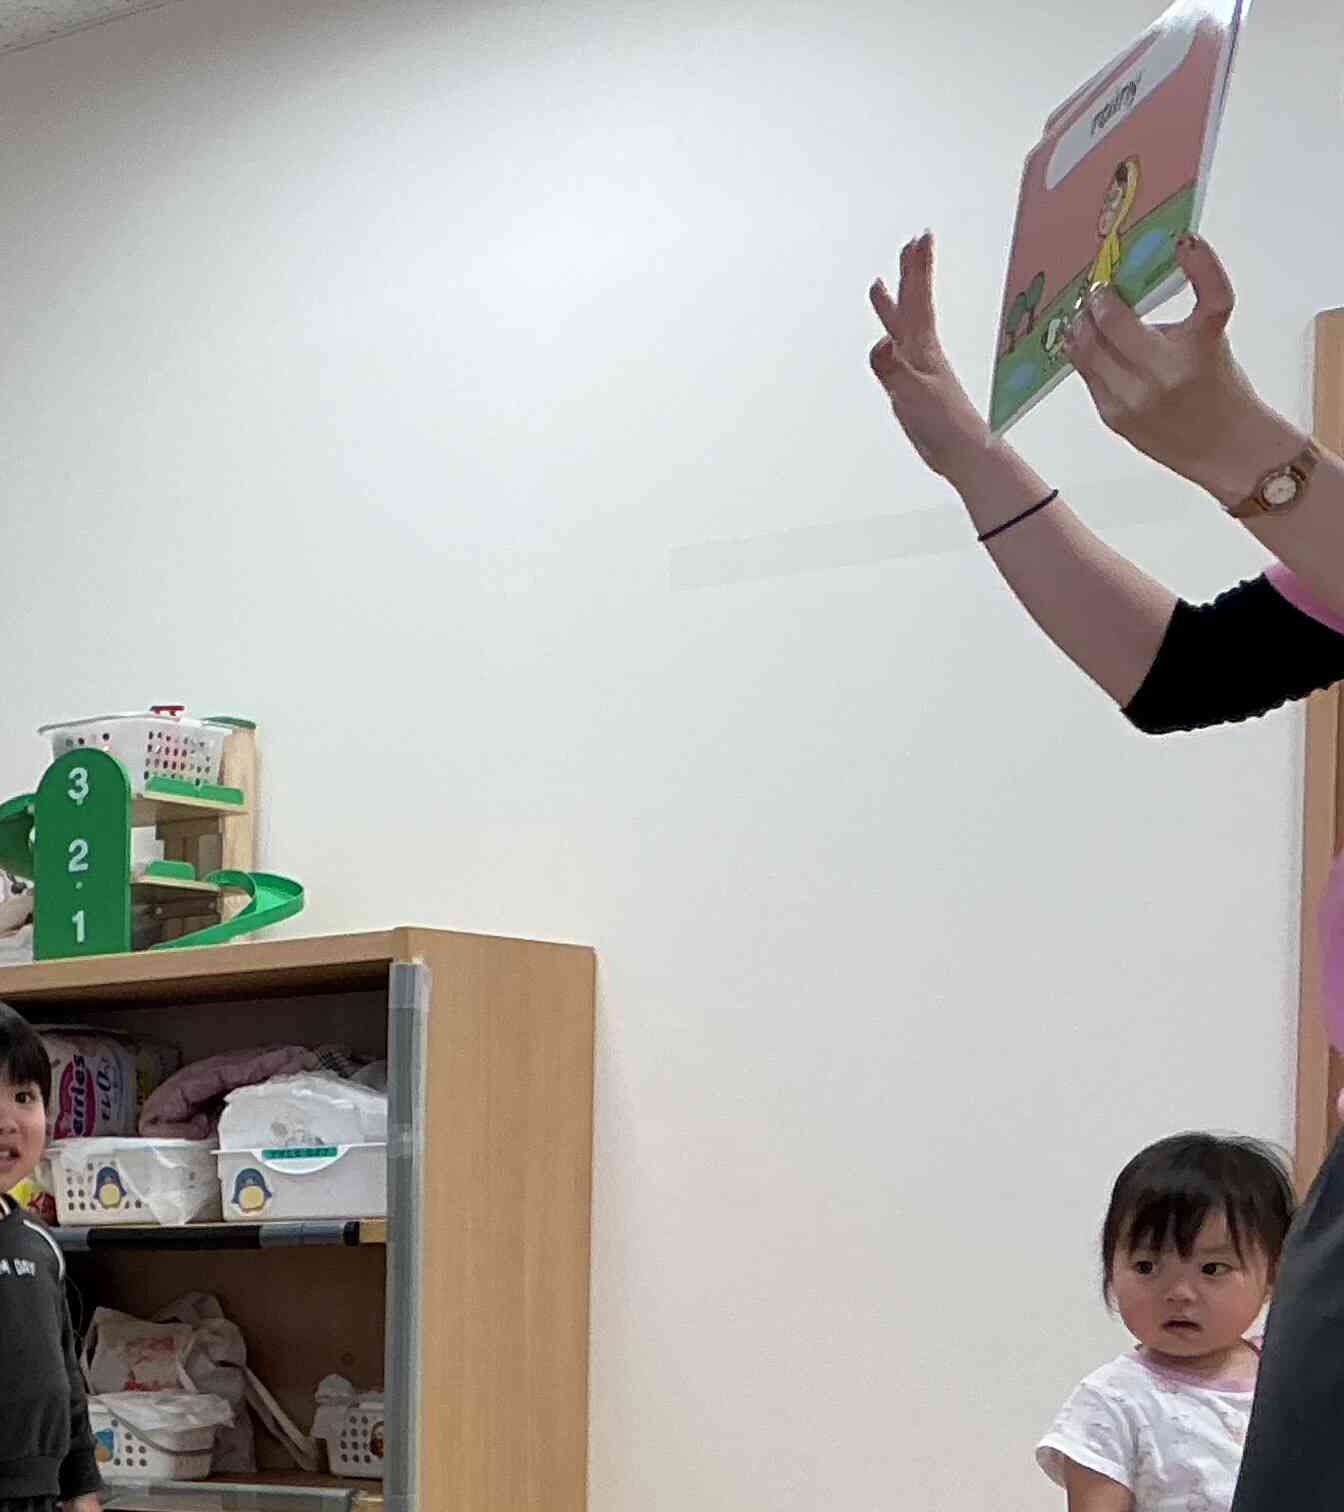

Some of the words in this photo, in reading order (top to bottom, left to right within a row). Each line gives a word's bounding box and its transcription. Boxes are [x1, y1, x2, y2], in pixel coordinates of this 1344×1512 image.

[68, 767, 89, 801] 3
[68, 839, 89, 872] 2
[72, 910, 85, 943] 1
[71, 1054, 86, 1136] erries
